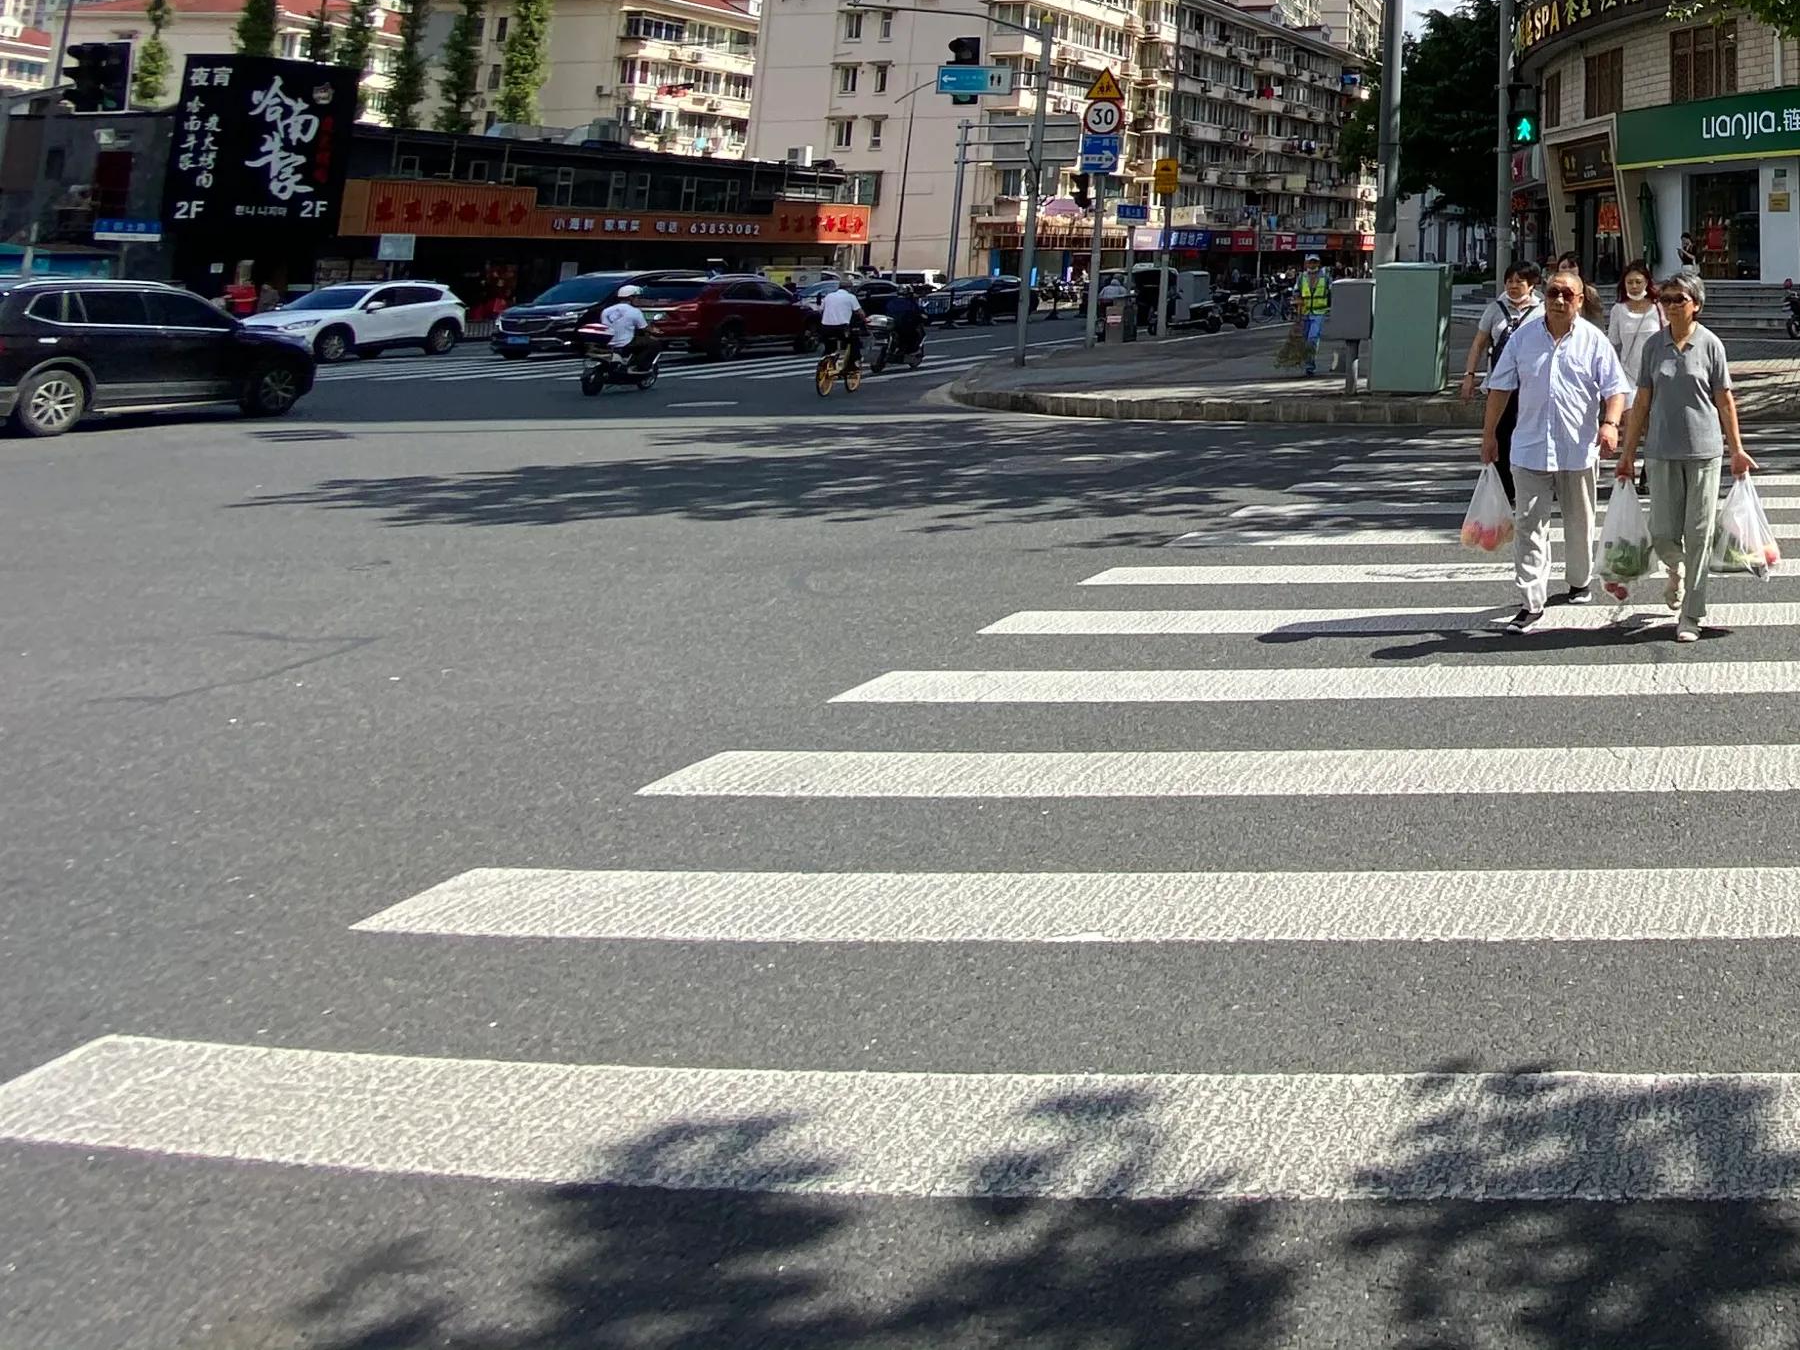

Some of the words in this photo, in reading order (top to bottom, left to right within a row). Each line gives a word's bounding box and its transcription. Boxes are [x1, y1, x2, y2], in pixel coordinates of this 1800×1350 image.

[190, 67, 233, 87] 夜宵
[1092, 108, 1114, 125] 30
[173, 201, 205, 219] 2F
[300, 201, 328, 218] 2F
[690, 223, 760, 236] 63853082
